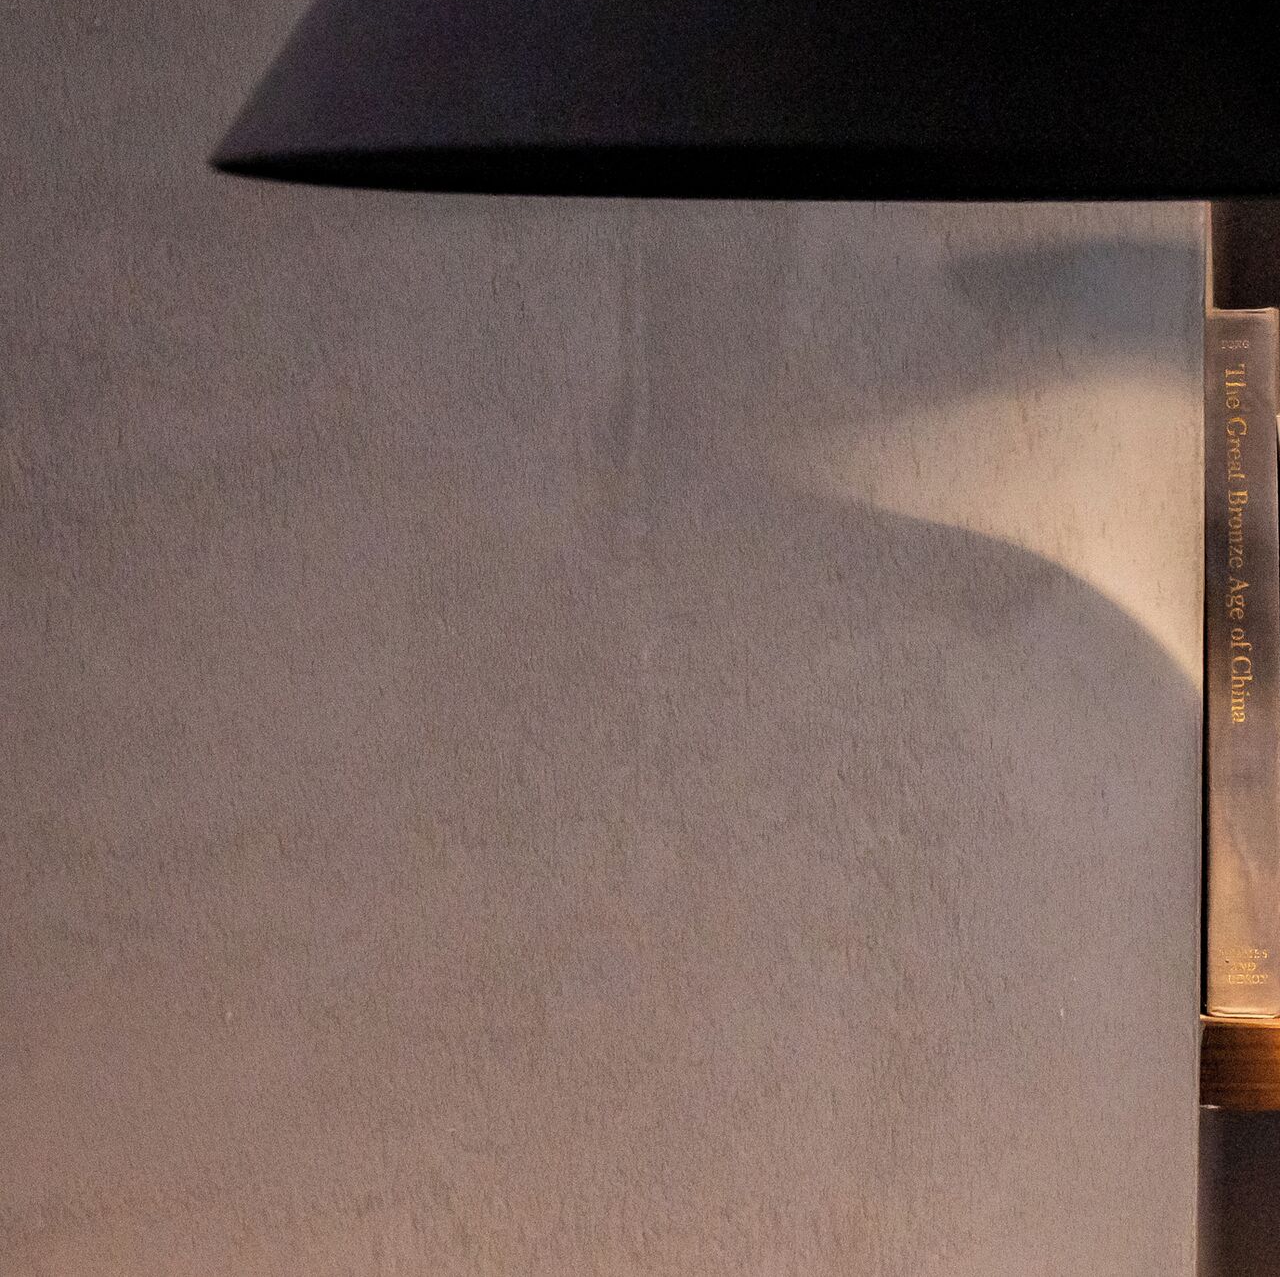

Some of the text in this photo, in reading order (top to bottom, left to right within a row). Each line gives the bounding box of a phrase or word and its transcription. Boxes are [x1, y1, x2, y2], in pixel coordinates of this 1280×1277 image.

[1226, 416, 1248, 484] Great
[1227, 489, 1249, 570] Bronze
[1225, 576, 1250, 621] Age
[1230, 626, 1252, 650] of
[1230, 655, 1254, 724] China
